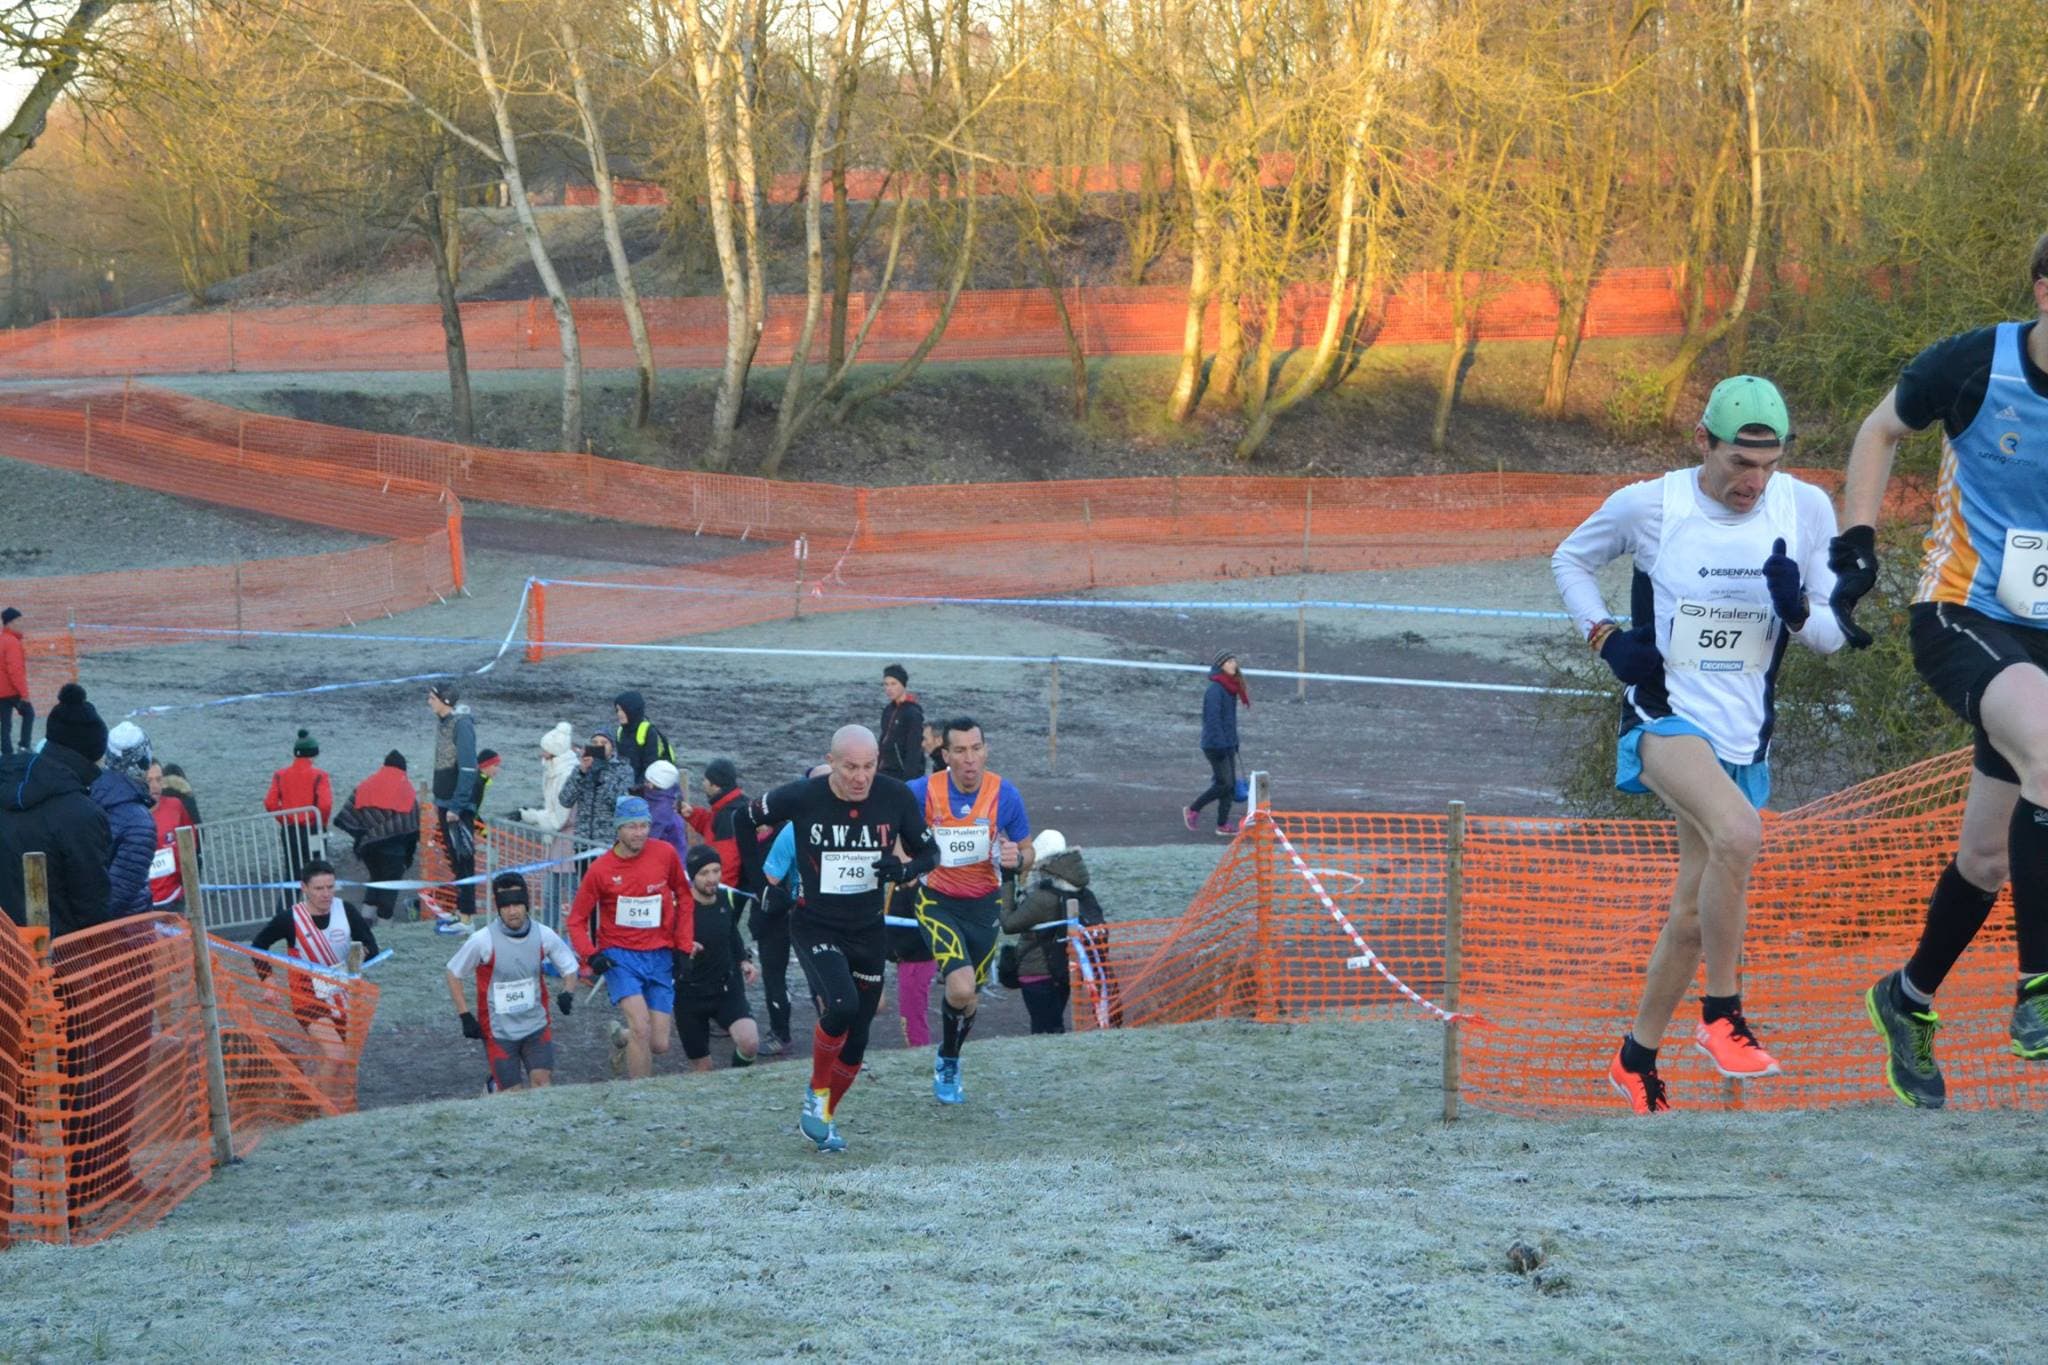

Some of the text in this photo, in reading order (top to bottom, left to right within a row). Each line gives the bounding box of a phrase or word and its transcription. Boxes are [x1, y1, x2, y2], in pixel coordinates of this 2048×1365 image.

[1710, 607, 1768, 623] Kalenji
[1698, 629, 1743, 649] 567
[950, 841, 975, 853] 669
[838, 866, 865, 878] 748
[629, 908, 649, 917] 514
[505, 991, 525, 1002] 564
